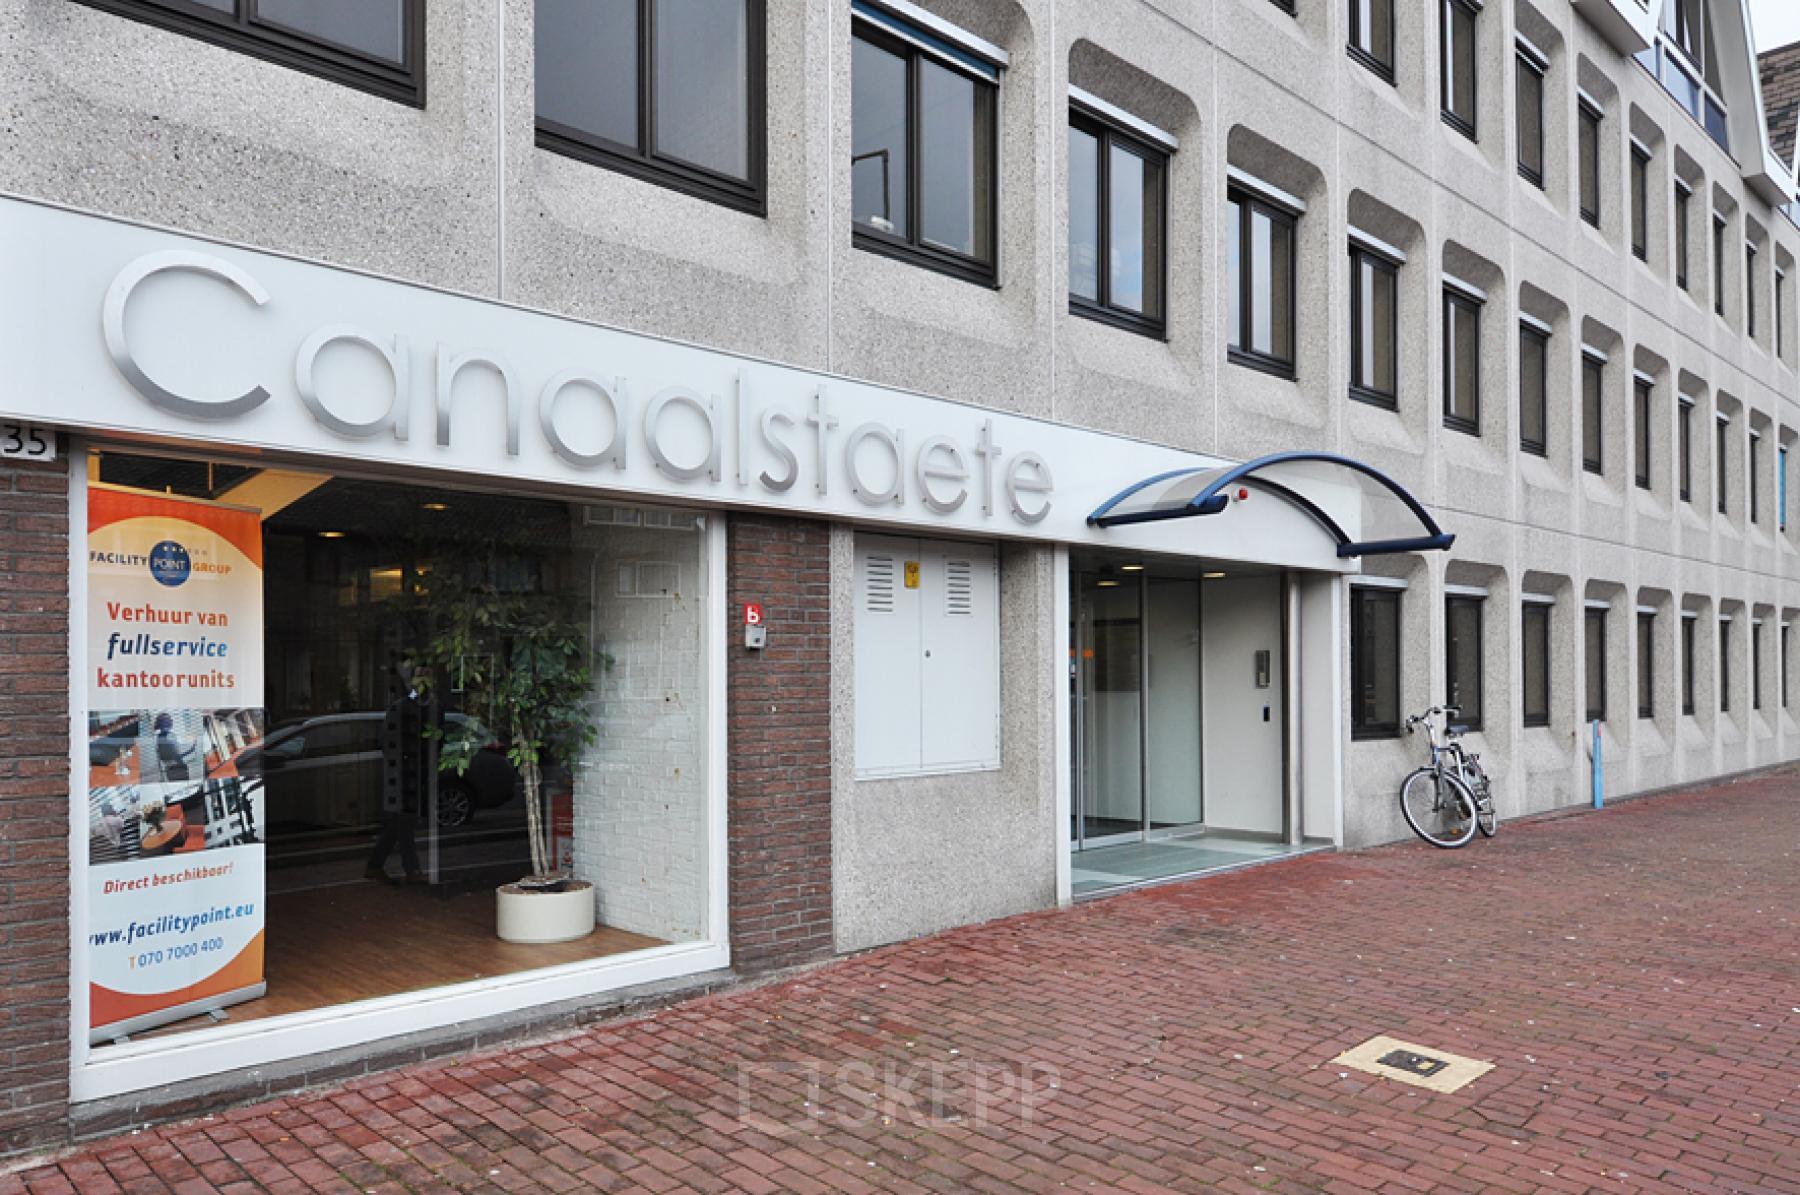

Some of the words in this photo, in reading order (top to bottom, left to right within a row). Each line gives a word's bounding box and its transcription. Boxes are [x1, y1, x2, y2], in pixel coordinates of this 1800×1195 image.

[103, 250, 1053, 524] Canaalstaete
[4, 424, 47, 455] 35
[89, 551, 148, 566] FACILITY
[153, 557, 186, 571] POINT
[192, 562, 232, 575] GROUP
[107, 601, 193, 625] Verhuur
[197, 611, 229, 627] van
[107, 631, 228, 661] fullservice
[97, 667, 235, 688] kantoorunits
[103, 875, 150, 894] Direct
[151, 861, 234, 887] beschikbaar!
[166, 942, 198, 961] 7000
[200, 936, 224, 952] 400
